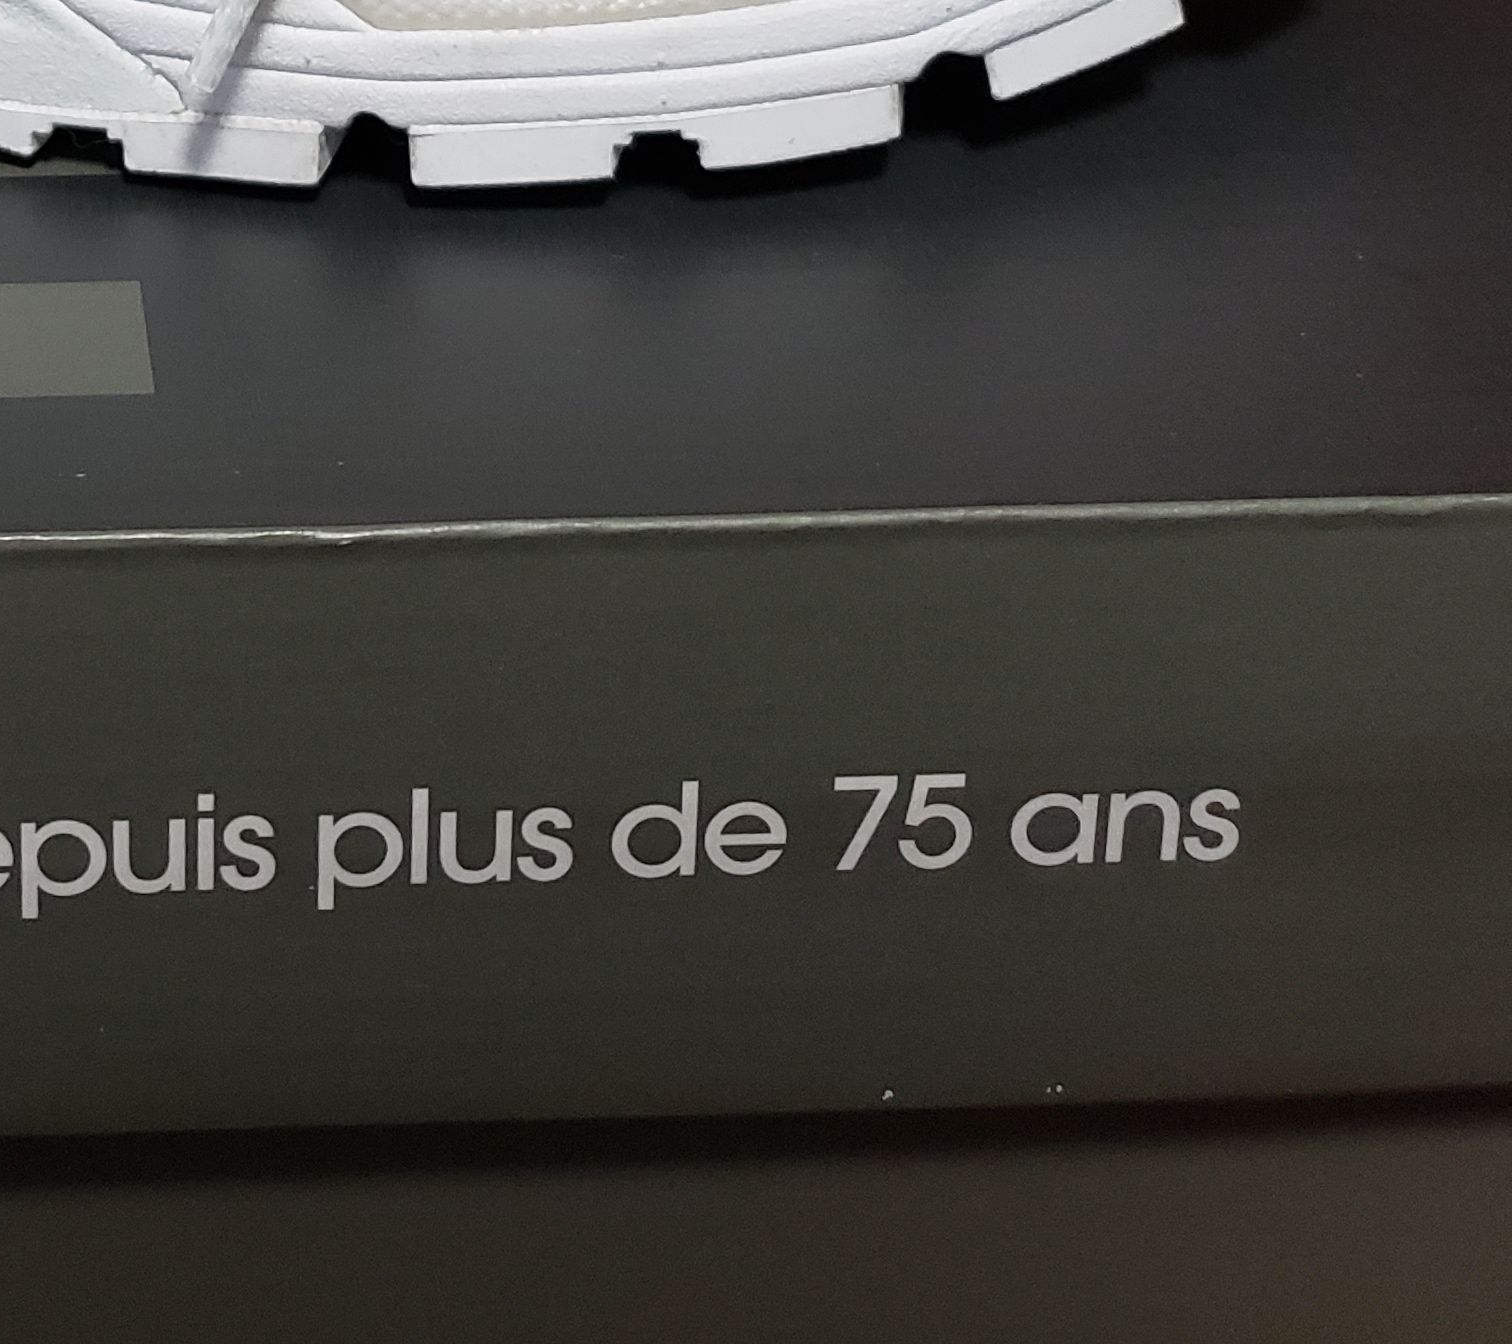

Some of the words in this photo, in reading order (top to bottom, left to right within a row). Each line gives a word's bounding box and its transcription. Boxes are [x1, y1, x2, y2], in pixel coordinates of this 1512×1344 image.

[317, 786, 573, 911] plus
[612, 780, 786, 879] de
[833, 773, 973, 871] 75
[1010, 788, 1241, 867] ans
